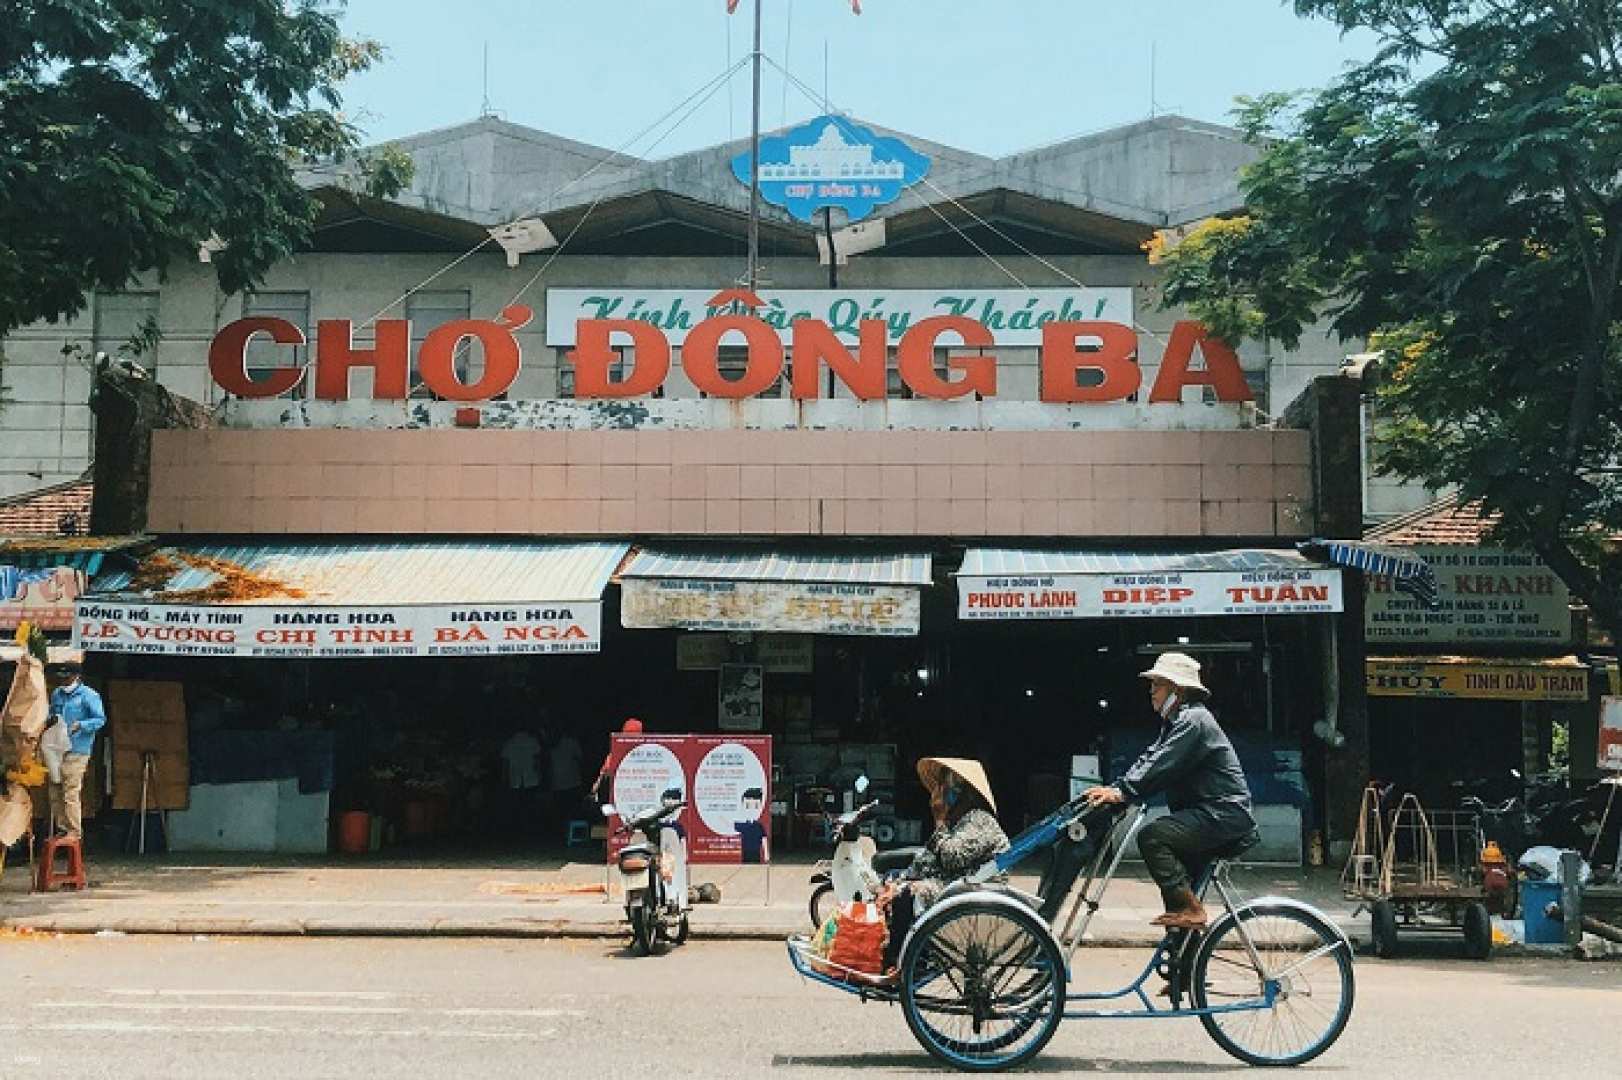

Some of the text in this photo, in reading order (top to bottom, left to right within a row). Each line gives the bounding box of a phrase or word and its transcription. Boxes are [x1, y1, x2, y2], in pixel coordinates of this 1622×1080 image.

[208, 288, 1256, 427] CHỢ ĐÔNG BA
[504, 623, 590, 641] NGA
